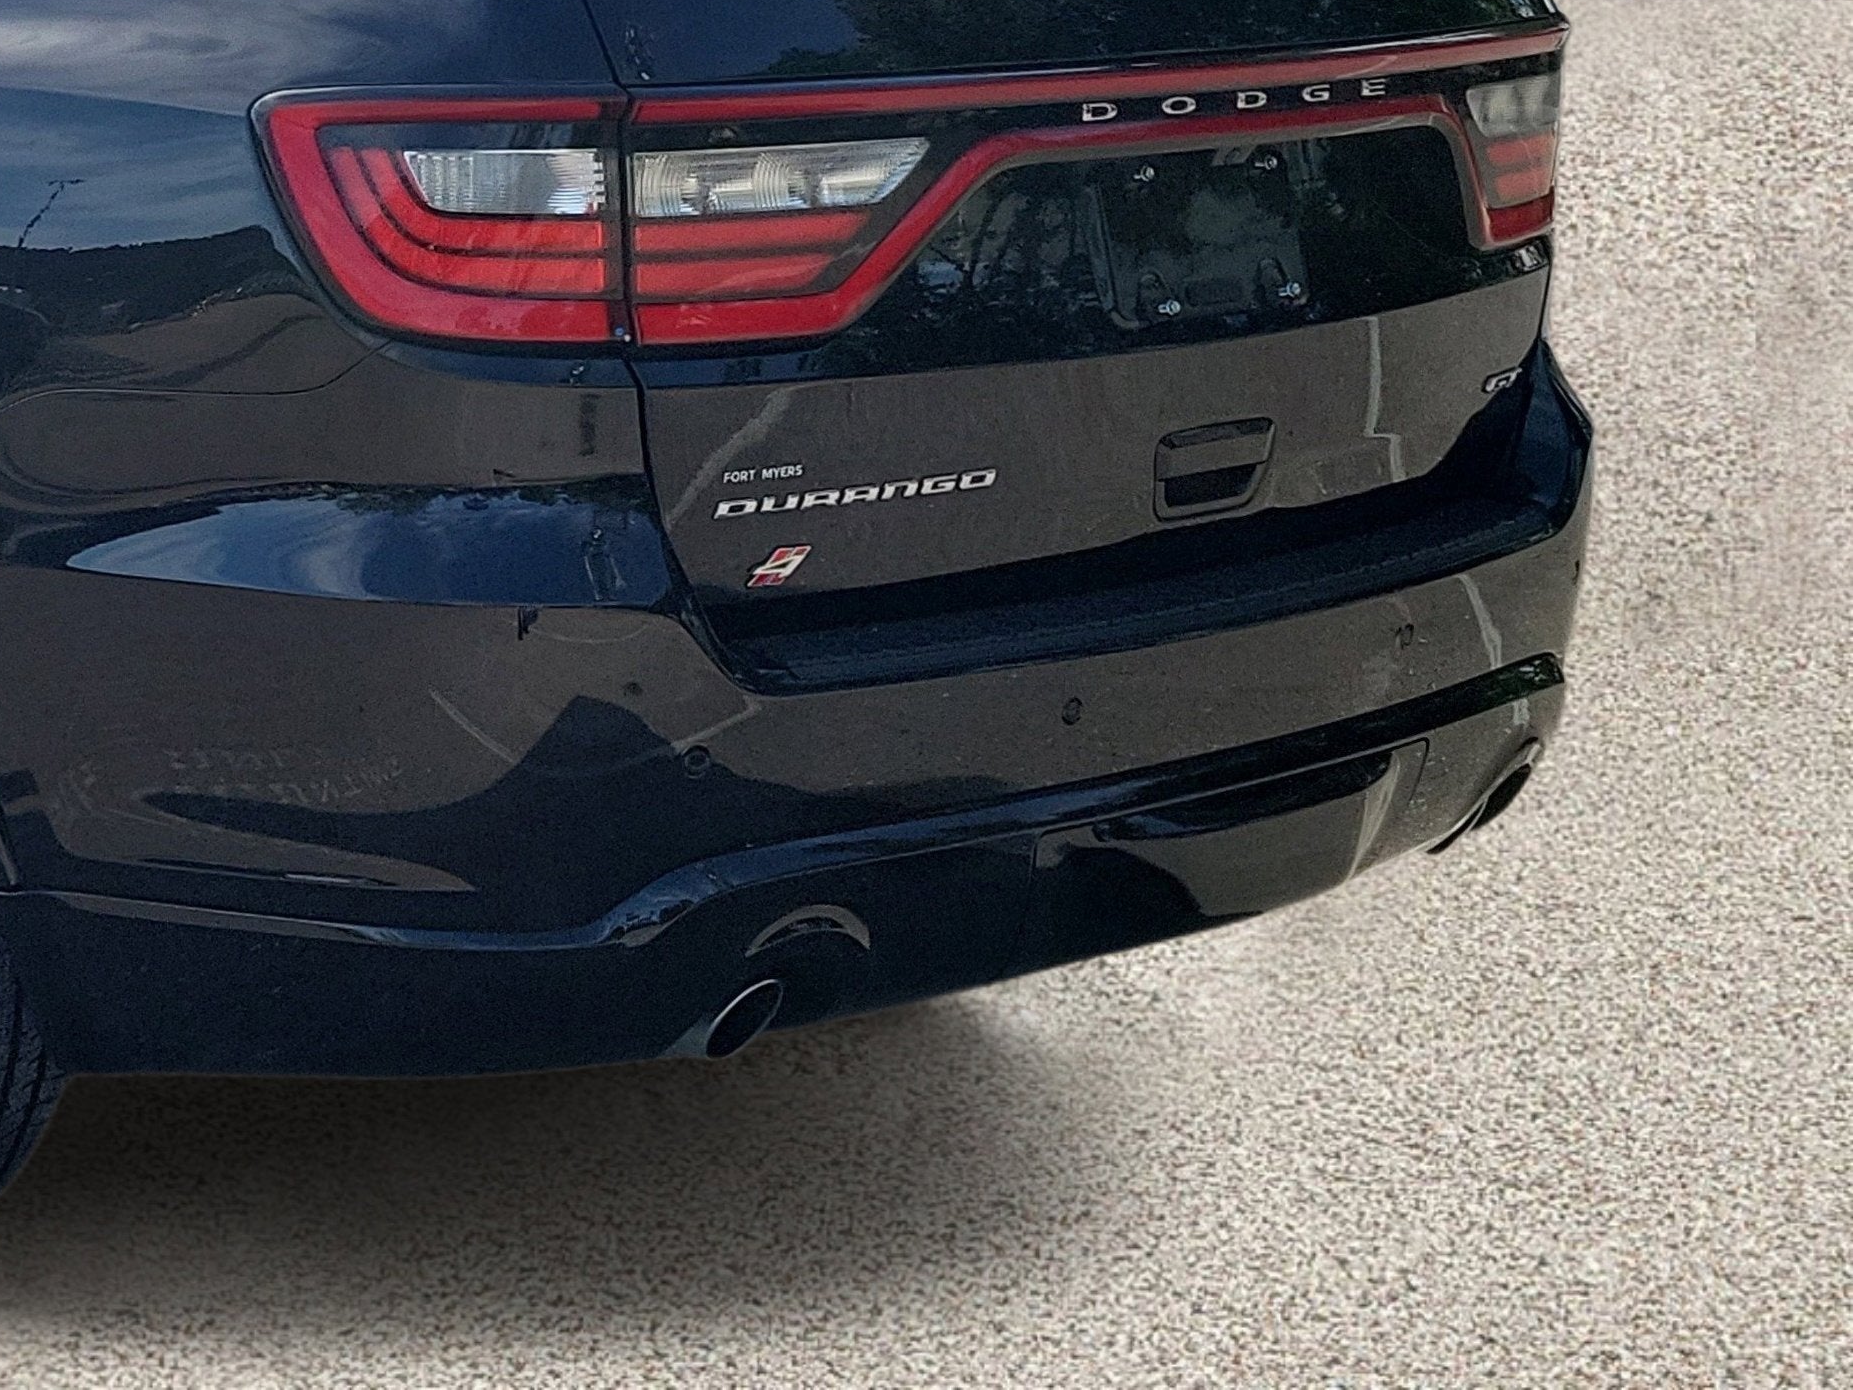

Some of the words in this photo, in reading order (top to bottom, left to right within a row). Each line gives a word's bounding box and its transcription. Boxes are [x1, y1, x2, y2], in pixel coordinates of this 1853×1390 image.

[1080, 77, 1388, 123] DODGE
[712, 467, 997, 520] DURANGO
[722, 468, 756, 485] FORT
[761, 463, 804, 481] MYERS
